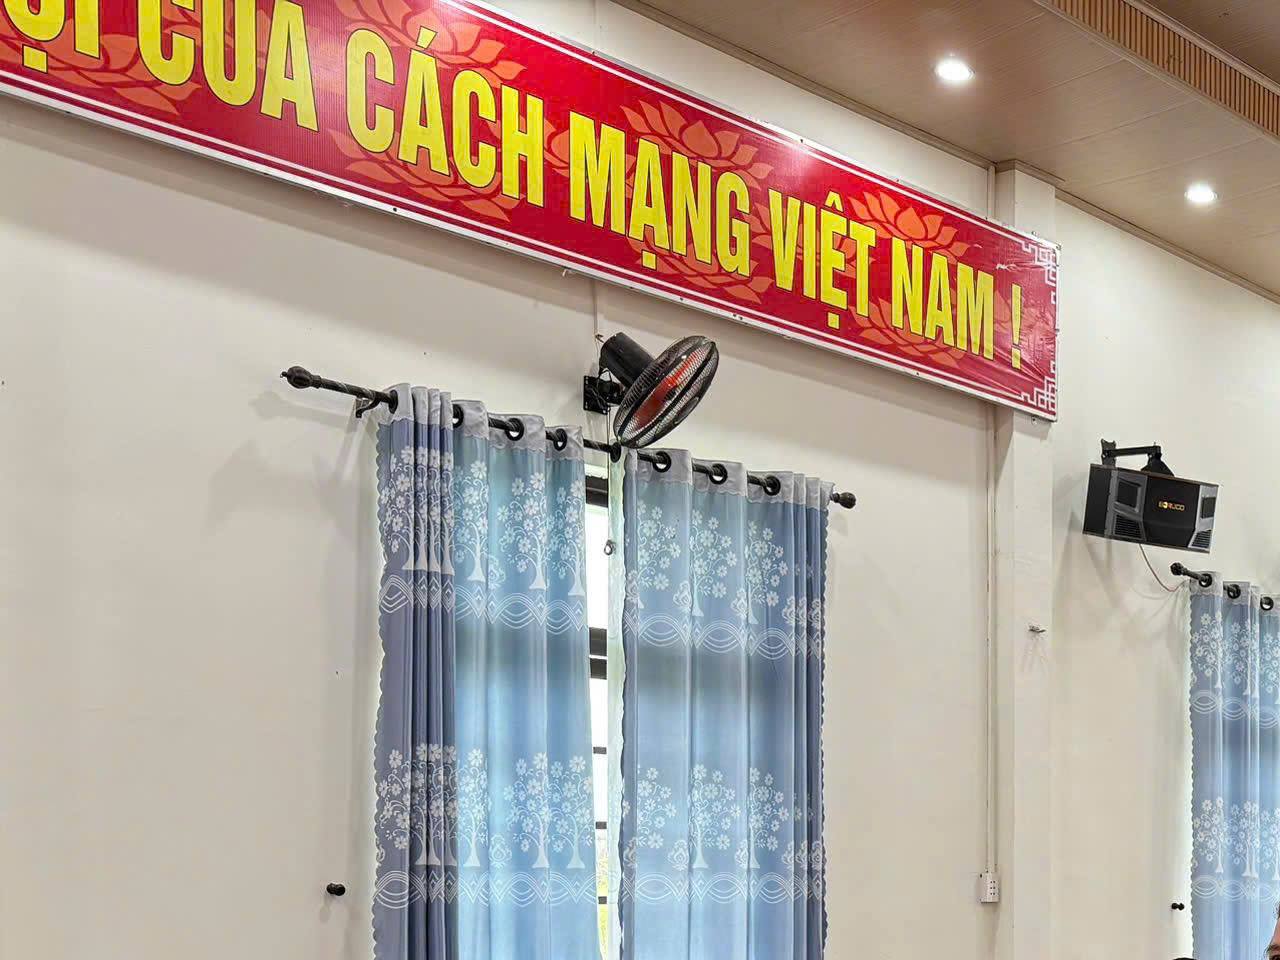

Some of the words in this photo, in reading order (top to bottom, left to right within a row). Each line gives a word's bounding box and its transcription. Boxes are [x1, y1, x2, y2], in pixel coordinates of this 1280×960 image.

[346, 27, 545, 208] CÁCH
[568, 110, 751, 277] MẠNG
[767, 189, 878, 329] VIỆT
[890, 236, 995, 361] NAM
[1010, 282, 1023, 369] !
